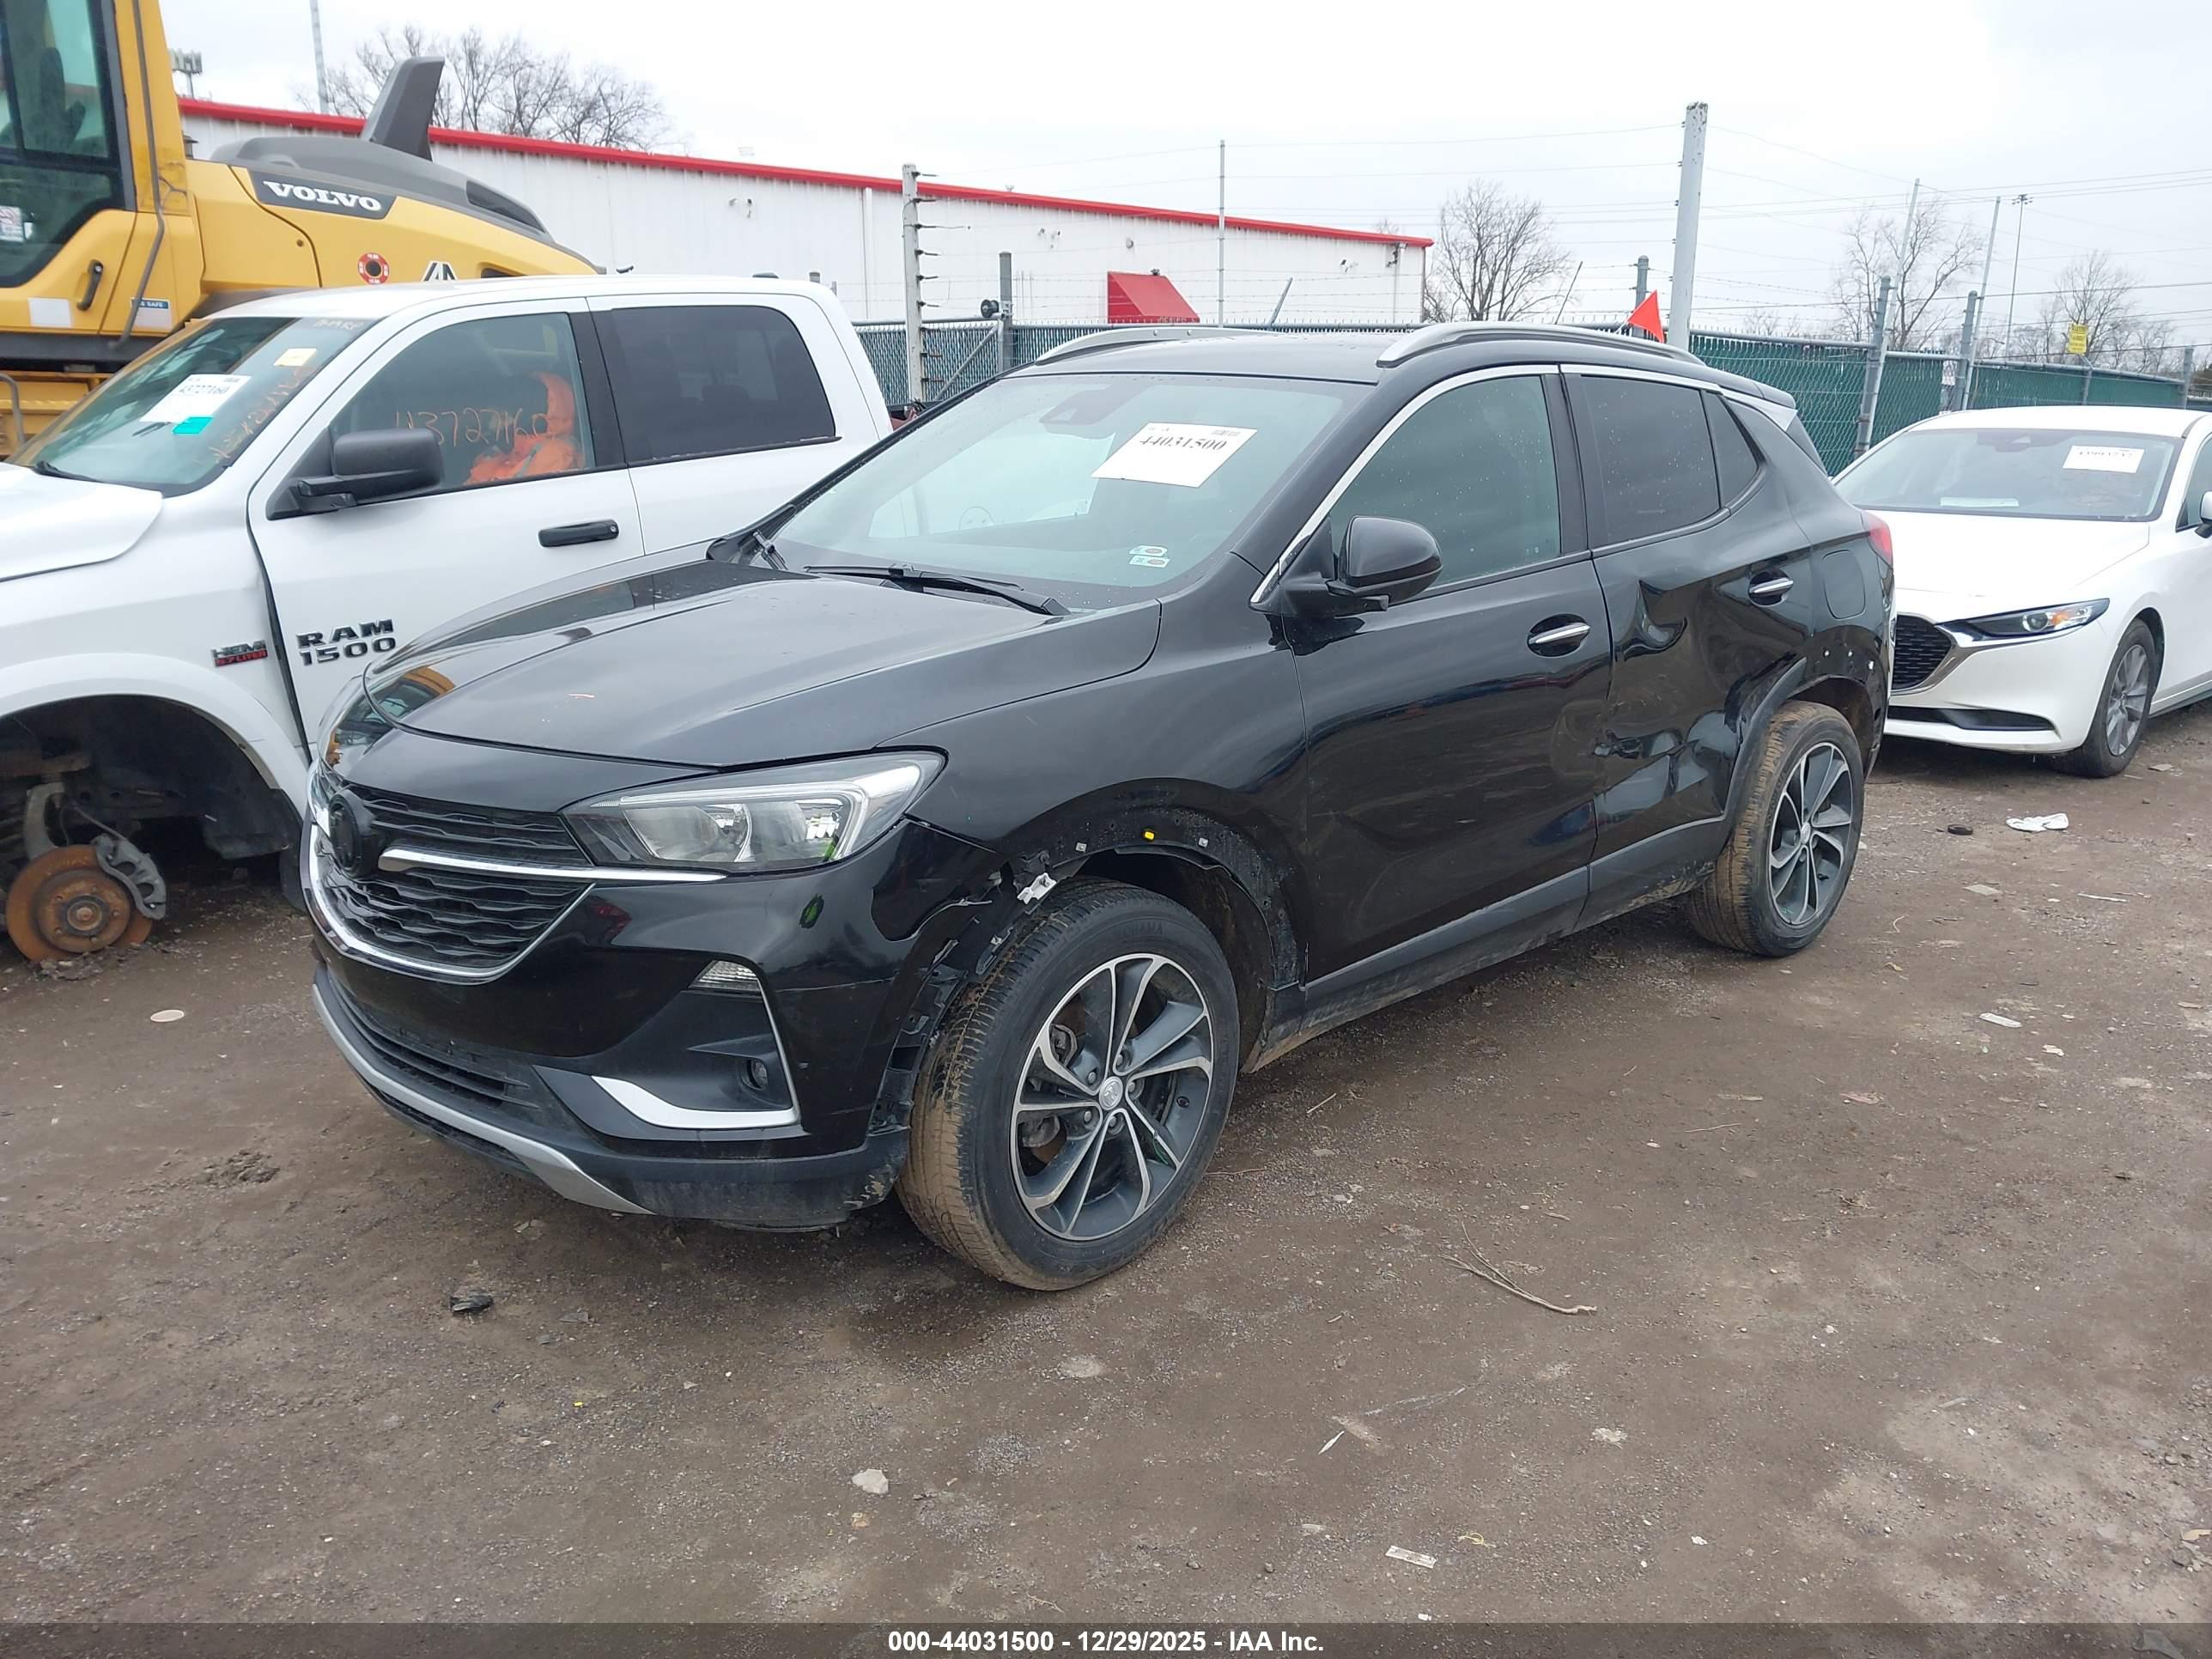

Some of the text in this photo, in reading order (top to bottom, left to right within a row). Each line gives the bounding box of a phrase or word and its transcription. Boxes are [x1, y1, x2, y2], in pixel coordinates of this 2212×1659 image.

[263, 180, 381, 211] VOLVO
[1139, 435, 1228, 451] 44031500
[295, 618, 394, 647] RAM
[300, 636, 397, 666] 1500
